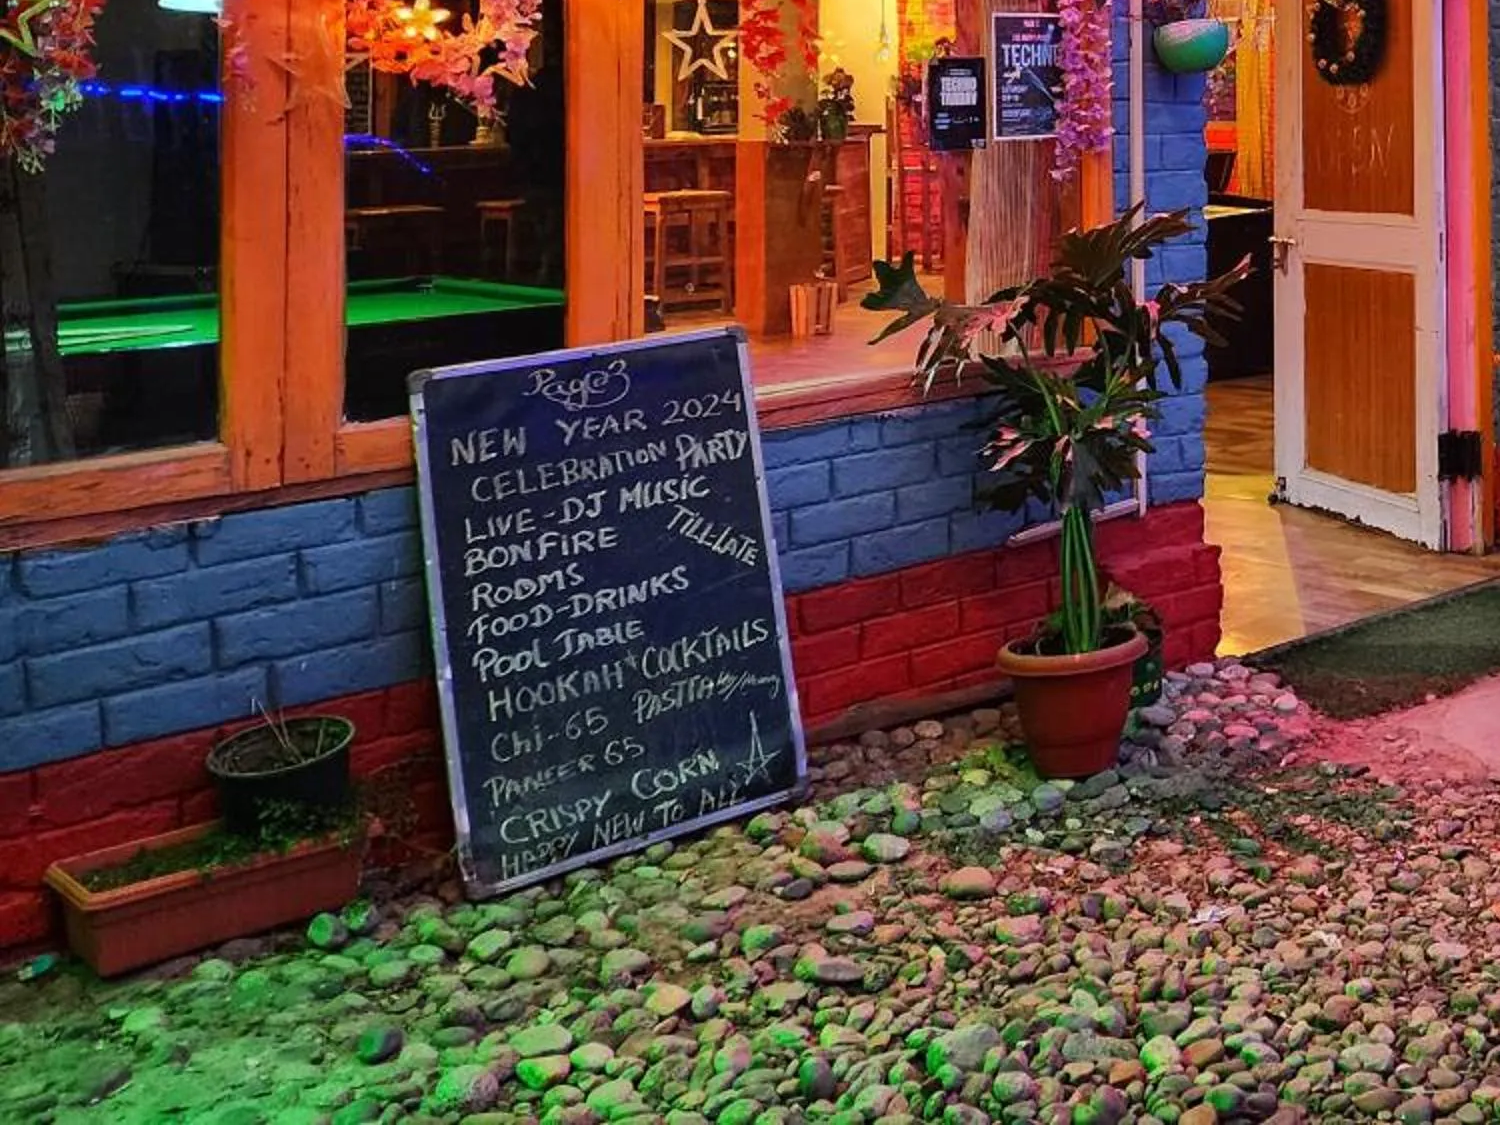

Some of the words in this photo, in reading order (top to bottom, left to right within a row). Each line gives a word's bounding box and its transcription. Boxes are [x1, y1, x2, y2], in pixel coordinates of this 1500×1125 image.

[451, 427, 526, 466] NEW
[555, 408, 647, 447] YEAR
[662, 391, 742, 426] 2024
[471, 439, 667, 503] CELEBRATION
[675, 429, 748, 472] PARTY
[553, 620, 645, 661] TABLE
[488, 661, 624, 723] HOOKAH
[604, 737, 646, 767] 65
[500, 790, 612, 846] CRISPY
[631, 748, 720, 800] CORN
[502, 830, 581, 880] HAPPY
[592, 810, 646, 847] NEW
[700, 781, 747, 817] ALL
